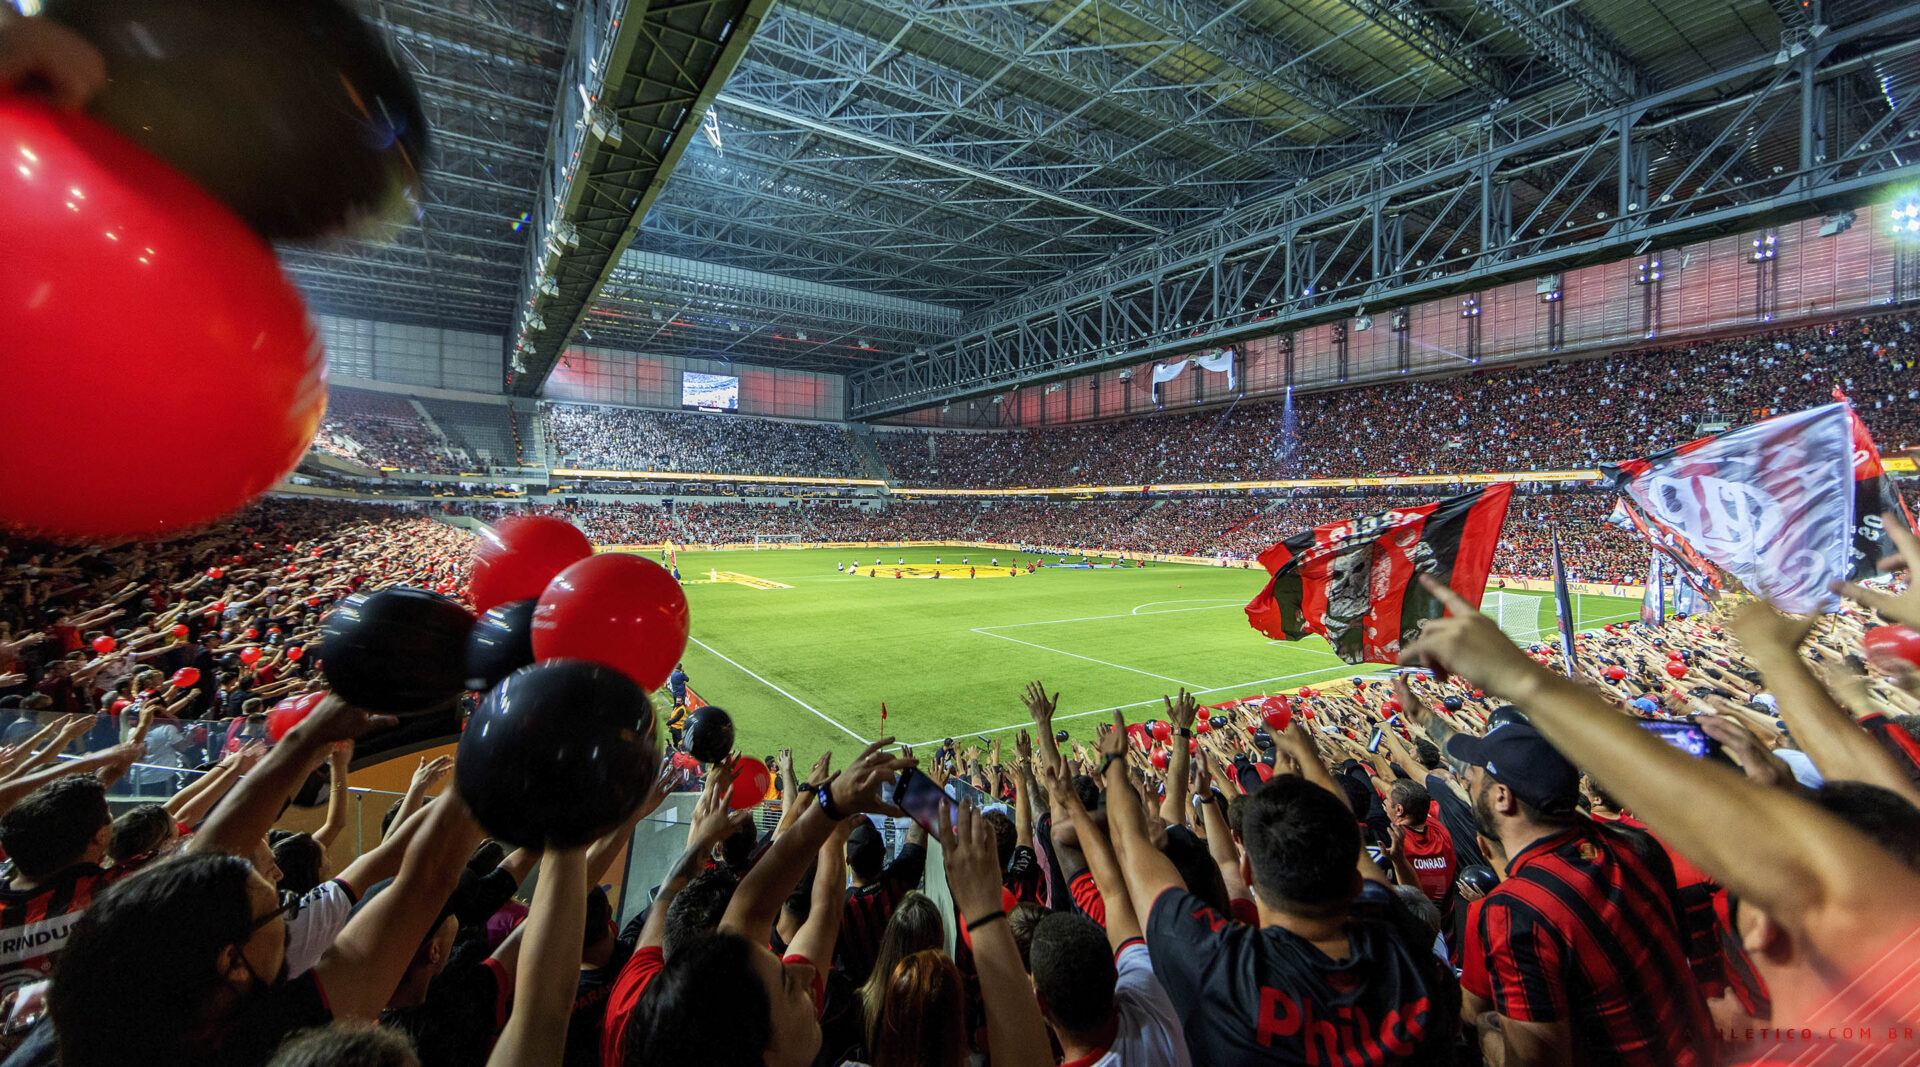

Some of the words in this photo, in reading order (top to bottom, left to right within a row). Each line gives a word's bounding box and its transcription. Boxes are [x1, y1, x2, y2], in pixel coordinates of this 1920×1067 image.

[1567, 583, 1589, 593] INAL
[1413, 857, 1446, 870] CONRADI
[0, 923, 77, 954] RINDU
